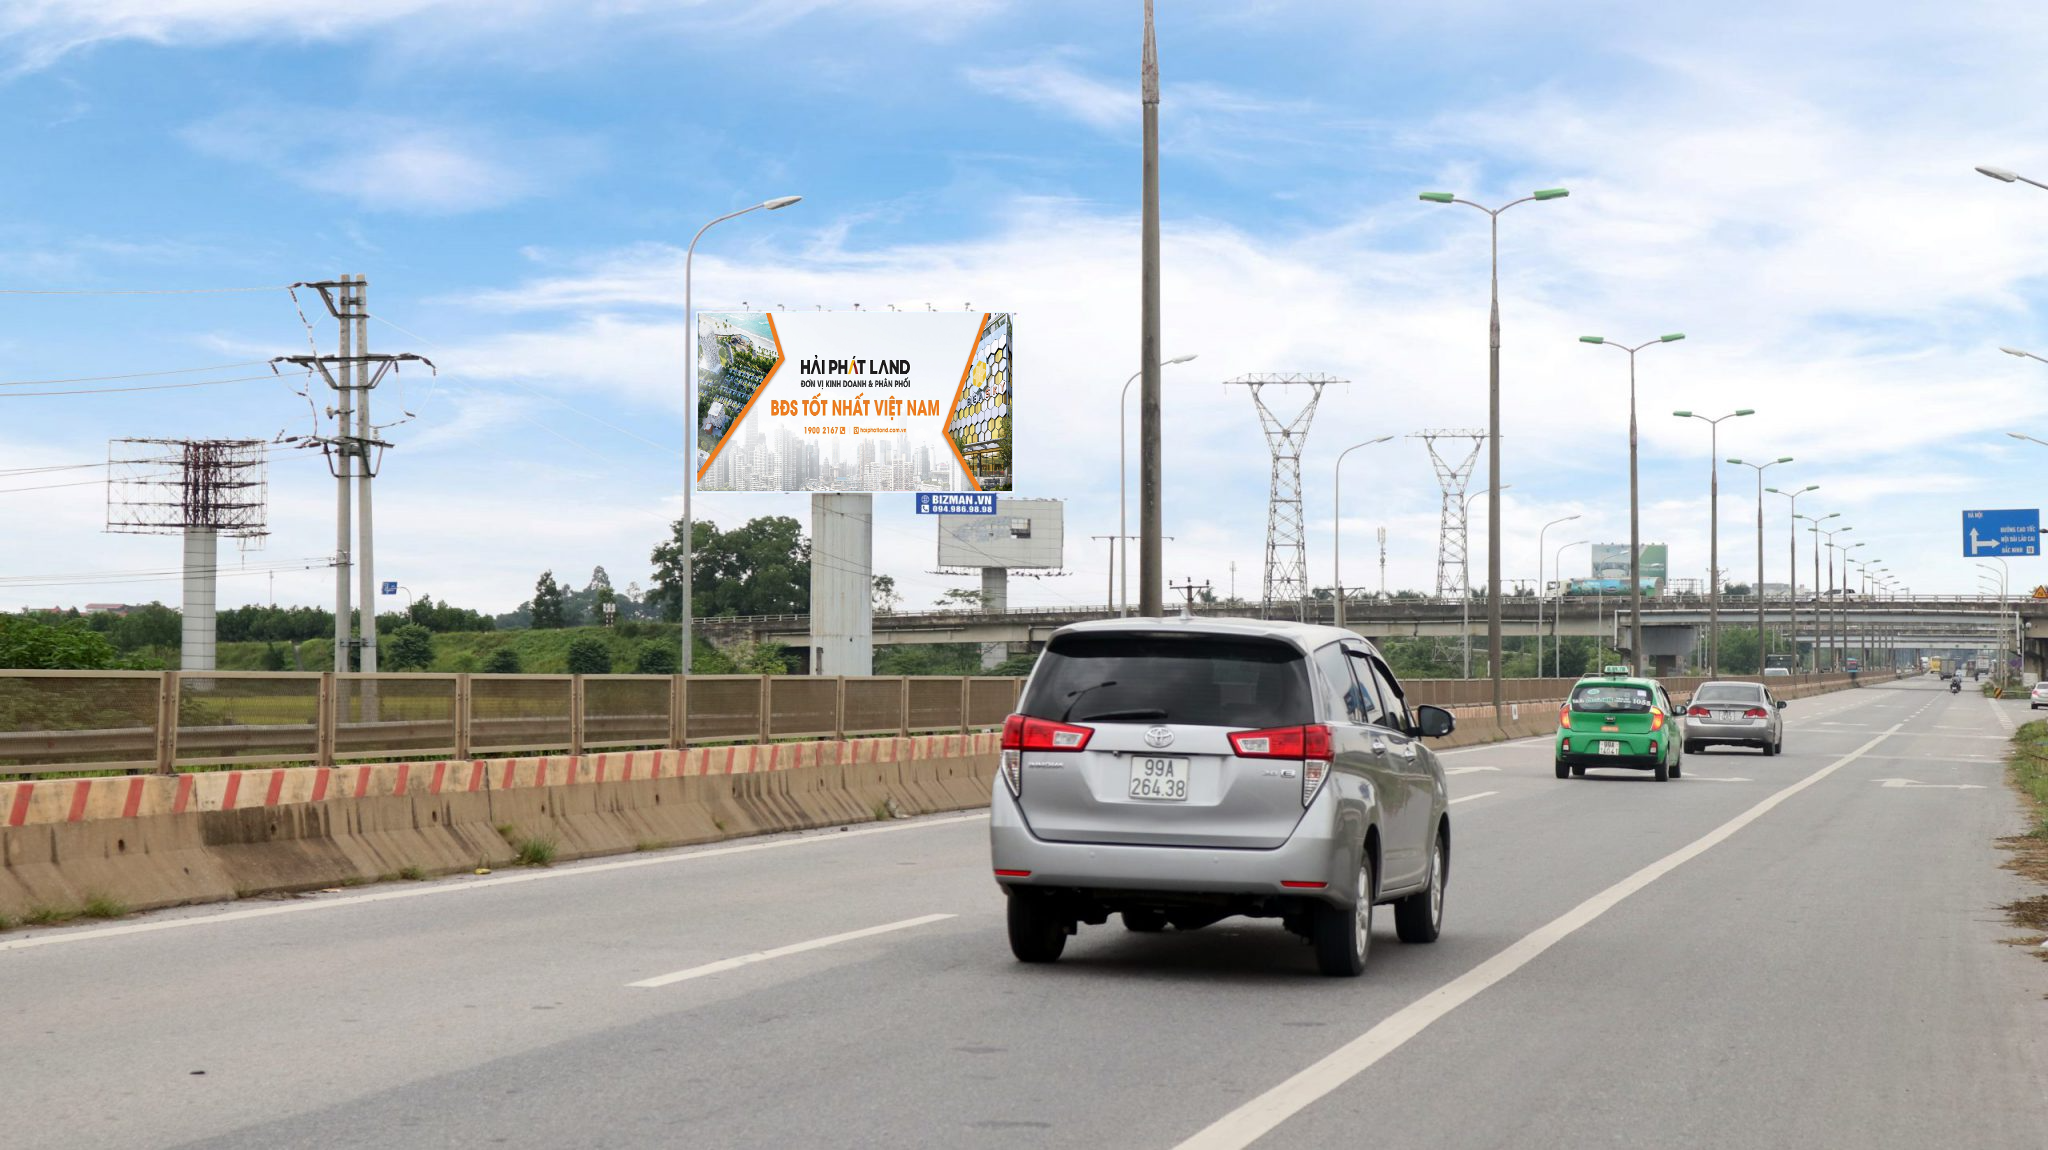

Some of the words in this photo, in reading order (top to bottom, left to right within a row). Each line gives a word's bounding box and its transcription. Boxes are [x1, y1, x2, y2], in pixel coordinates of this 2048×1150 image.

[800, 354, 825, 375] HẢI
[828, 355, 866, 375] PHÁT
[869, 359, 911, 375] LAND
[800, 378, 816, 388] ĐƠN
[817, 379, 824, 389] VỊ
[825, 379, 841, 388] KINH
[842, 379, 867, 388] DOANH
[868, 379, 874, 388] &
[874, 378, 893, 388] PHÂN
[894, 376, 911, 388] PHỐI
[770, 399, 798, 417] BĐS
[801, 392, 828, 417] TỐT
[832, 391, 870, 417] NHẤT
[874, 395, 903, 421] VIỆT
[906, 399, 940, 417] NAM
[804, 426, 821, 435] 1900
[822, 426, 839, 435] 2167
[1144, 759, 1174, 777] 99A
[1131, 778, 1185, 797] 264.38
